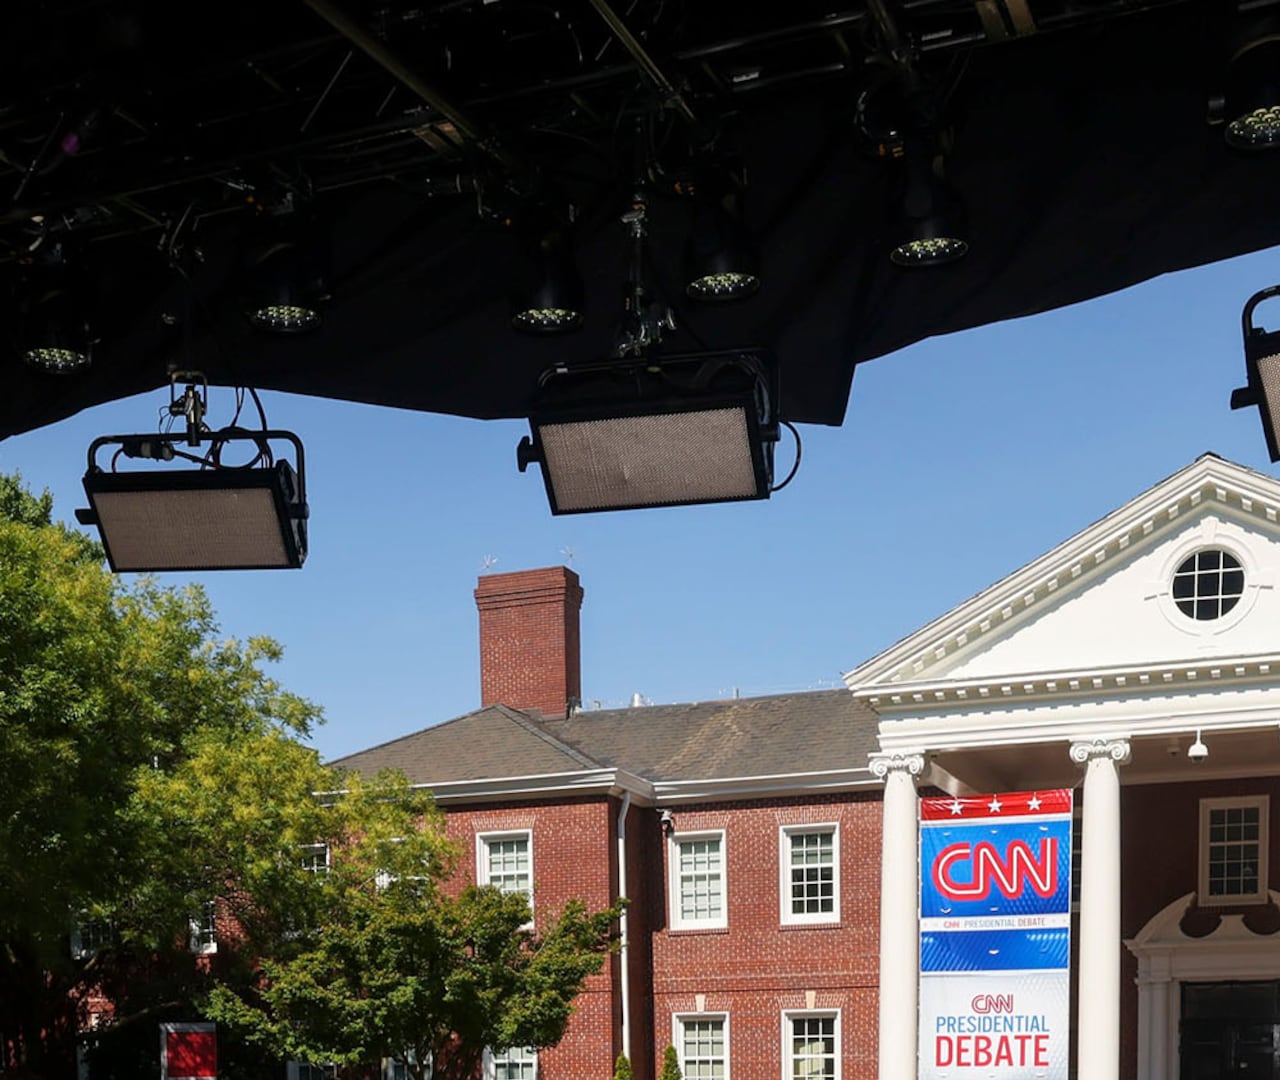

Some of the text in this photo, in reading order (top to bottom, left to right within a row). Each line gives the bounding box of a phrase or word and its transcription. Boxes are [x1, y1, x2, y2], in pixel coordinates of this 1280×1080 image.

[932, 837, 1059, 902] CNN
[943, 917, 1046, 930] CNN PRESIDENTIAL DEBATE
[971, 994, 1014, 1014] CNN
[936, 1015, 1050, 1034] PRESIDENTIAL
[935, 1035, 1050, 1067] DEBATE
